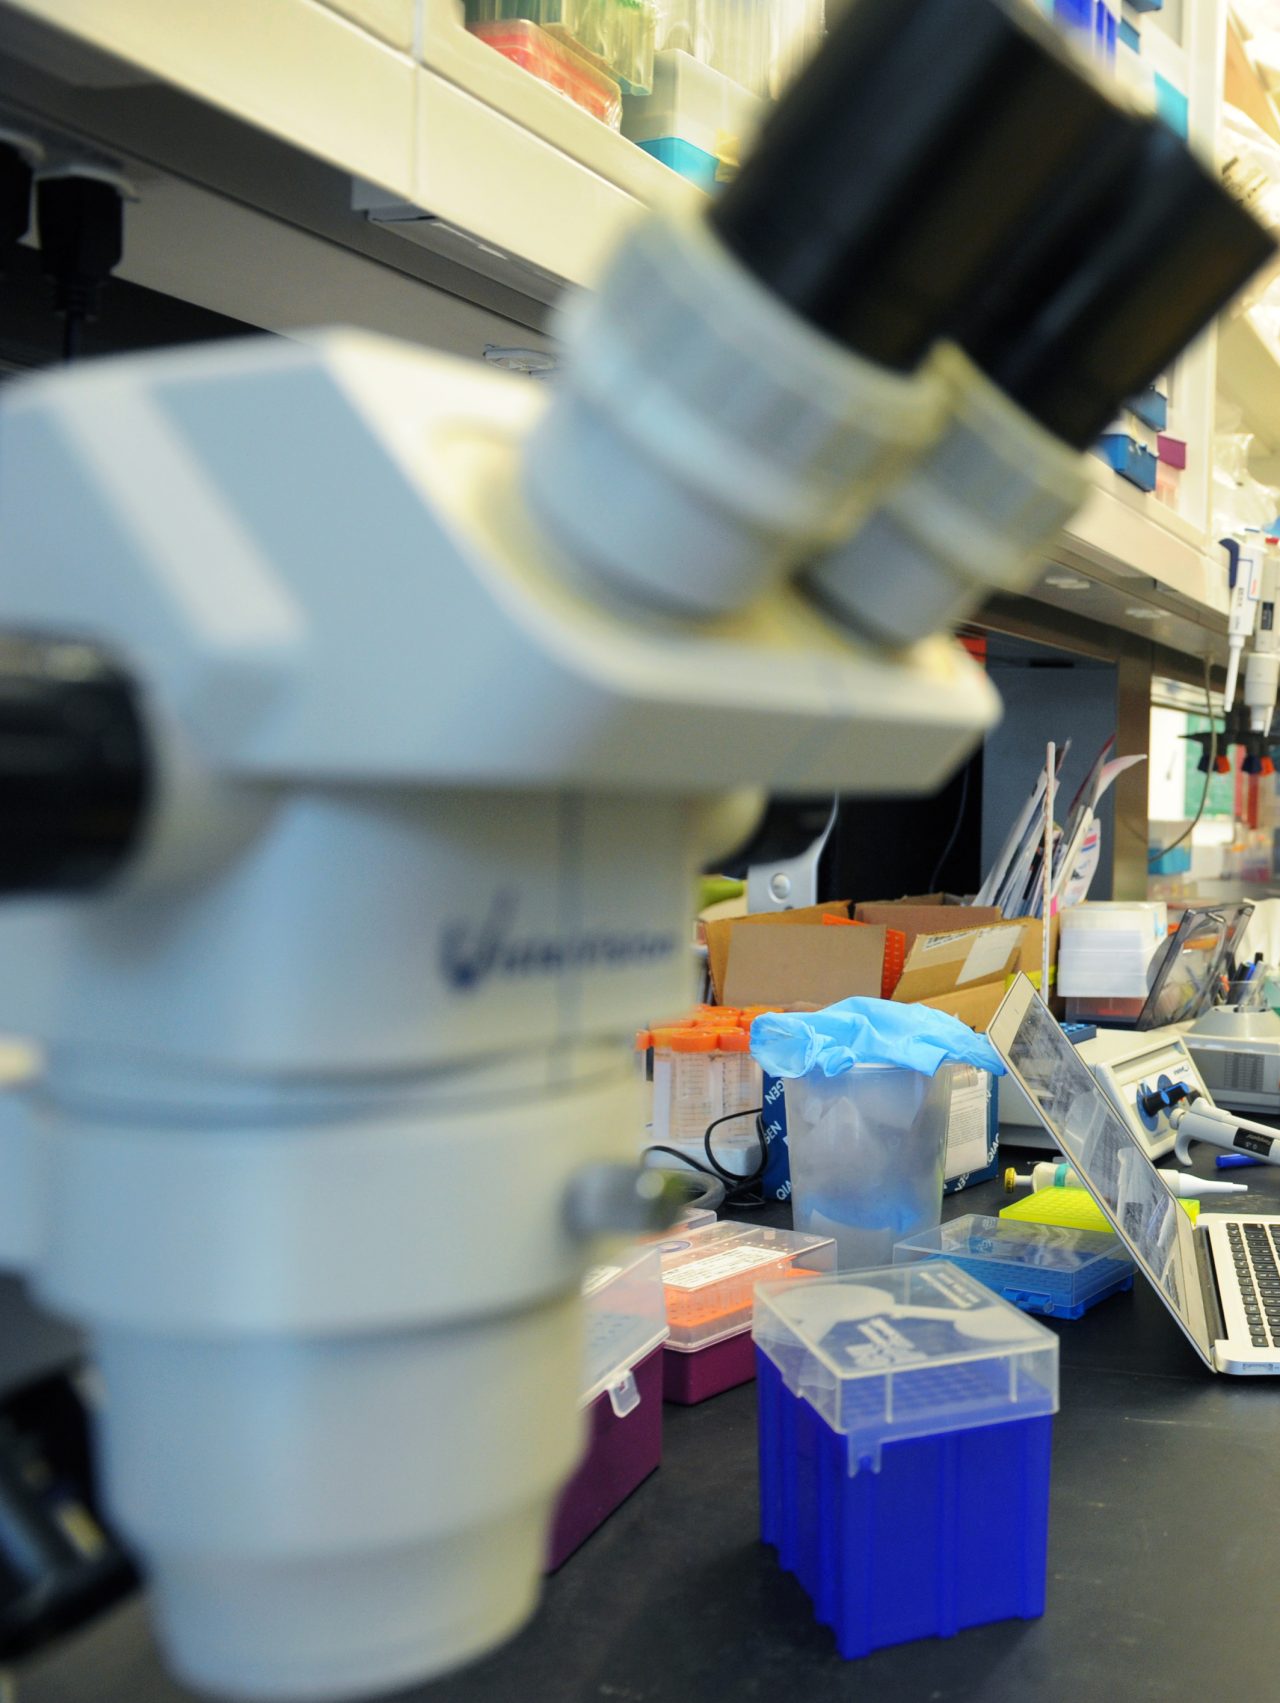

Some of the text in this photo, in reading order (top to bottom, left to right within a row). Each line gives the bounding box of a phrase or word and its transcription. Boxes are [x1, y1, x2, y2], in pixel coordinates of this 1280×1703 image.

[764, 1079, 785, 1104] GEN
[764, 1120, 782, 1145] GEN
[776, 1180, 792, 1201] QIA
